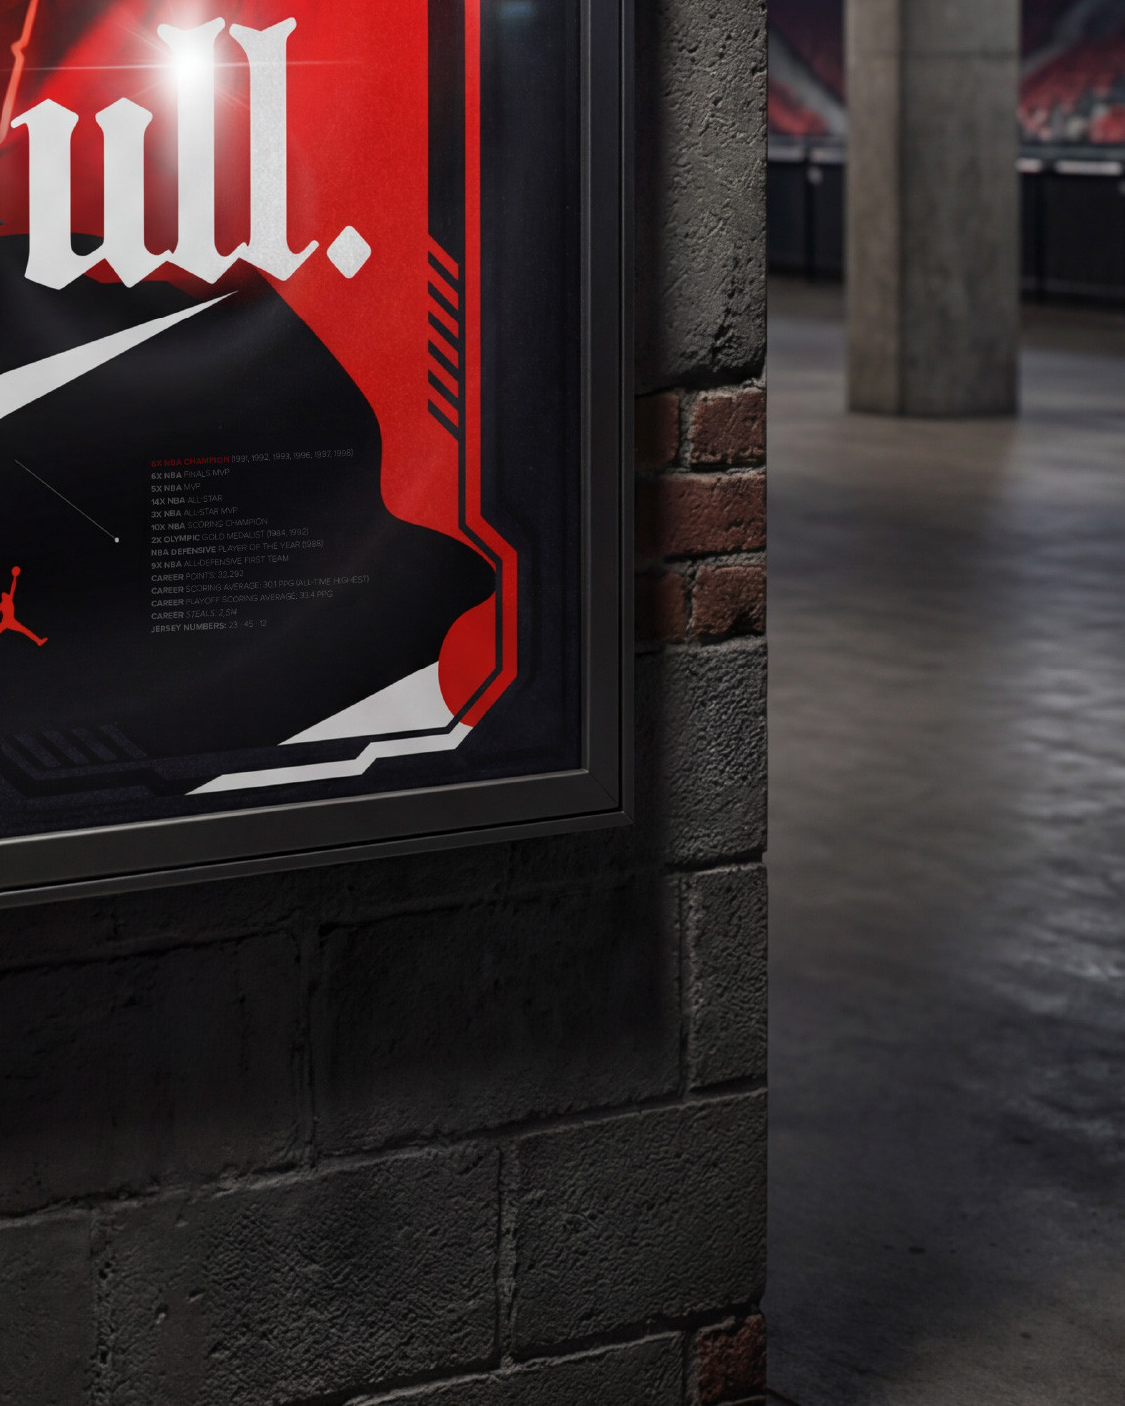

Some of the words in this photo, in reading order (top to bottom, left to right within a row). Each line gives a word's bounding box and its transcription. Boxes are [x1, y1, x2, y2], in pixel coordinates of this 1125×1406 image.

[164, 458, 182, 466] NBA
[183, 456, 230, 465] CHAMPION
[151, 472, 162, 480] 6X
[164, 471, 182, 479] NBA
[183, 470, 211, 478] FINALS
[212, 468, 230, 476] MVP
[164, 484, 182, 492] NBA
[183, 483, 201, 491] MVP
[188, 494, 223, 503] ALL-STAR
[164, 509, 182, 517] NBA
[183, 507, 219, 516] ALL-STAR
[220, 506, 238, 514] MVP
[151, 523, 166, 531] 10X
[168, 522, 186, 530] NBA
[187, 520, 223, 529] SCORING
[225, 517, 268, 526] CHAMPION
[163, 534, 201, 543] OLYMPIC
[202, 533, 224, 541] GOLD
[226, 530, 265, 539] MEDALIST
[151, 548, 169, 556] NBA
[171, 546, 216, 555] DEFENSIVE
[218, 544, 247, 552] PLAYER
[249, 543, 261, 551] OF
[263, 542, 278, 550] THE
[280, 541, 301, 549] YEAR
[164, 560, 182, 568] NBA
[183, 557, 242, 567] ALL-DEFENSIVE
[244, 556, 265, 564] FIRST
[268, 554, 289, 562] TEAM
[151, 573, 184, 582] CAREER
[151, 586, 184, 594] CAREER
[185, 584, 221, 593] SCORING
[151, 599, 184, 607] CAREER
[185, 597, 220, 605] PLAYOFF
[222, 594, 258, 603] SCORING
[316, 590, 333, 598] PPG
[151, 611, 184, 620] CAREER
[151, 624, 181, 633] JERSEY
[183, 622, 226, 631] NUMBERS:
